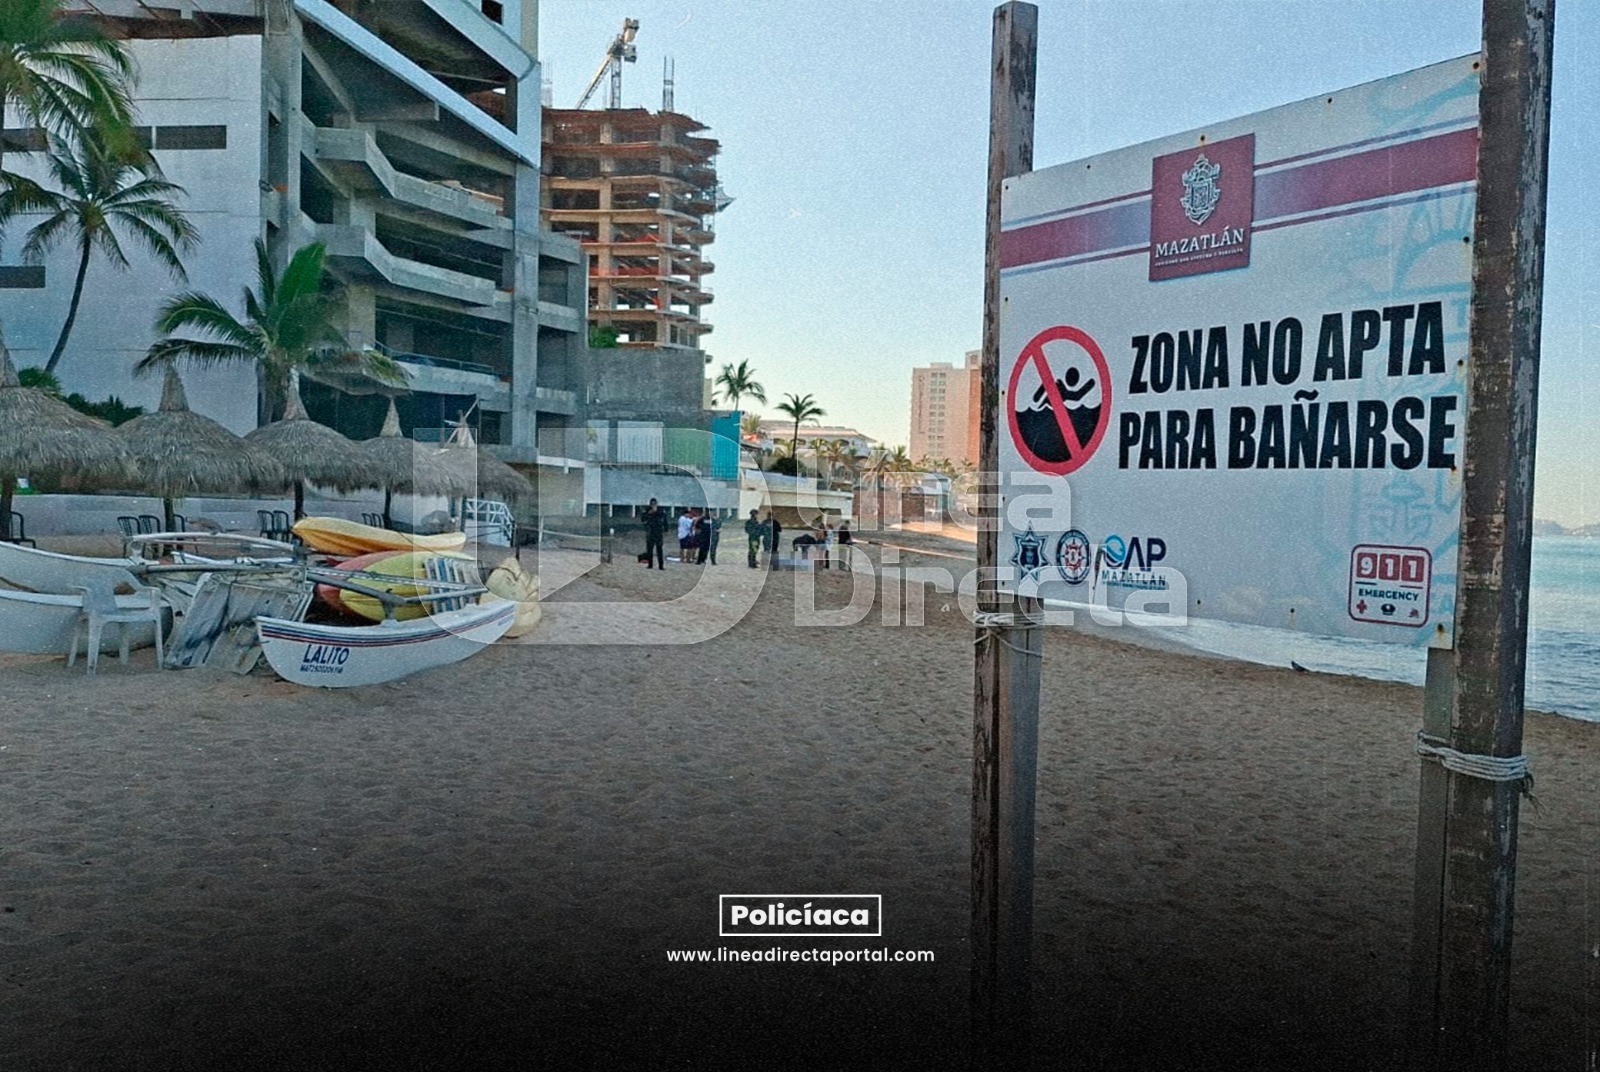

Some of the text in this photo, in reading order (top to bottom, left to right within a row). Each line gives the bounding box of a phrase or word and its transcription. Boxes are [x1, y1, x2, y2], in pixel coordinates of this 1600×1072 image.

[1155, 225, 1244, 258] MAZATLÁN
[1129, 301, 1446, 394] ZONA NO APTA
[1119, 389, 1457, 471] PARA BAÑARSE
[1102, 569, 1166, 586] MAZATLÁN
[1359, 555, 1420, 580] 911
[1358, 588, 1419, 601] EMERGENCY
[303, 644, 350, 665] LALITO
